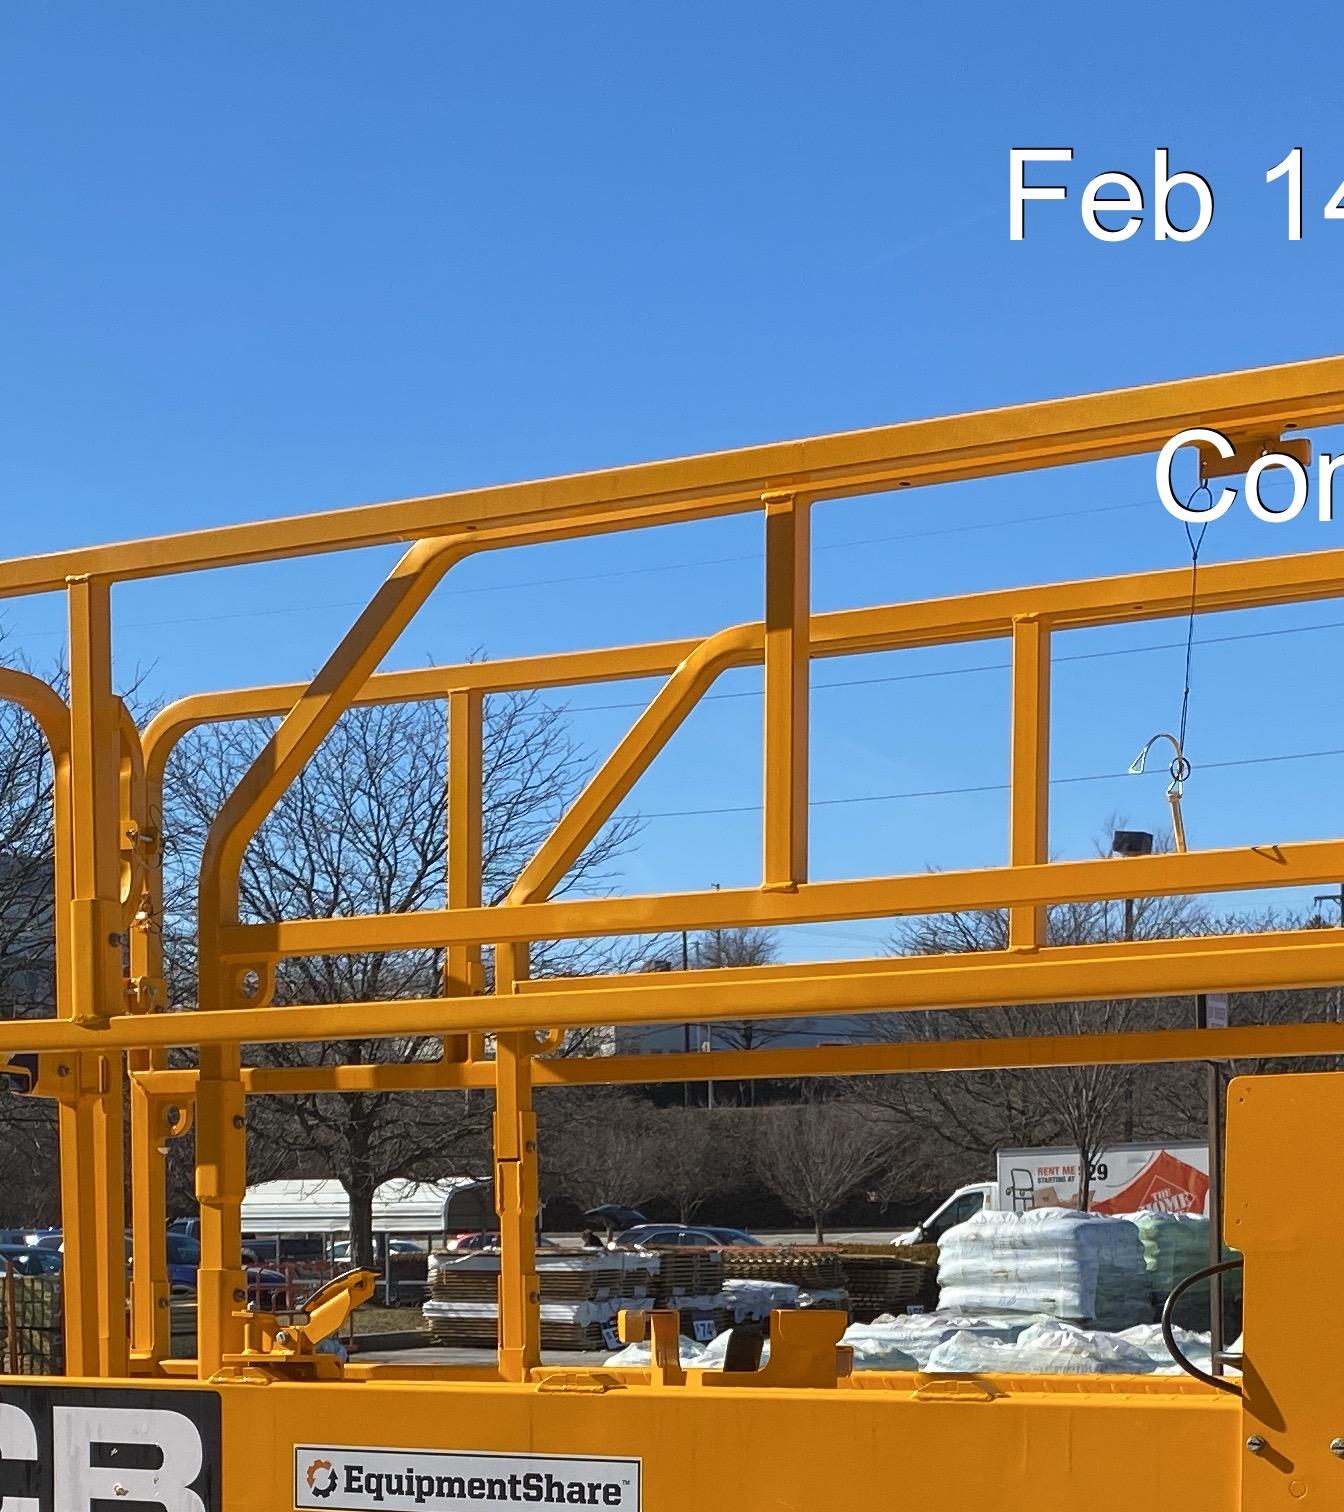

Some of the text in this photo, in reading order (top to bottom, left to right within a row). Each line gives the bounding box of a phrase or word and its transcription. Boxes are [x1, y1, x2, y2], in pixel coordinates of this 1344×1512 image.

[1037, 1163, 1108, 1181] RENT ME 29
[343, 1464, 622, 1506] EquipmentShare
